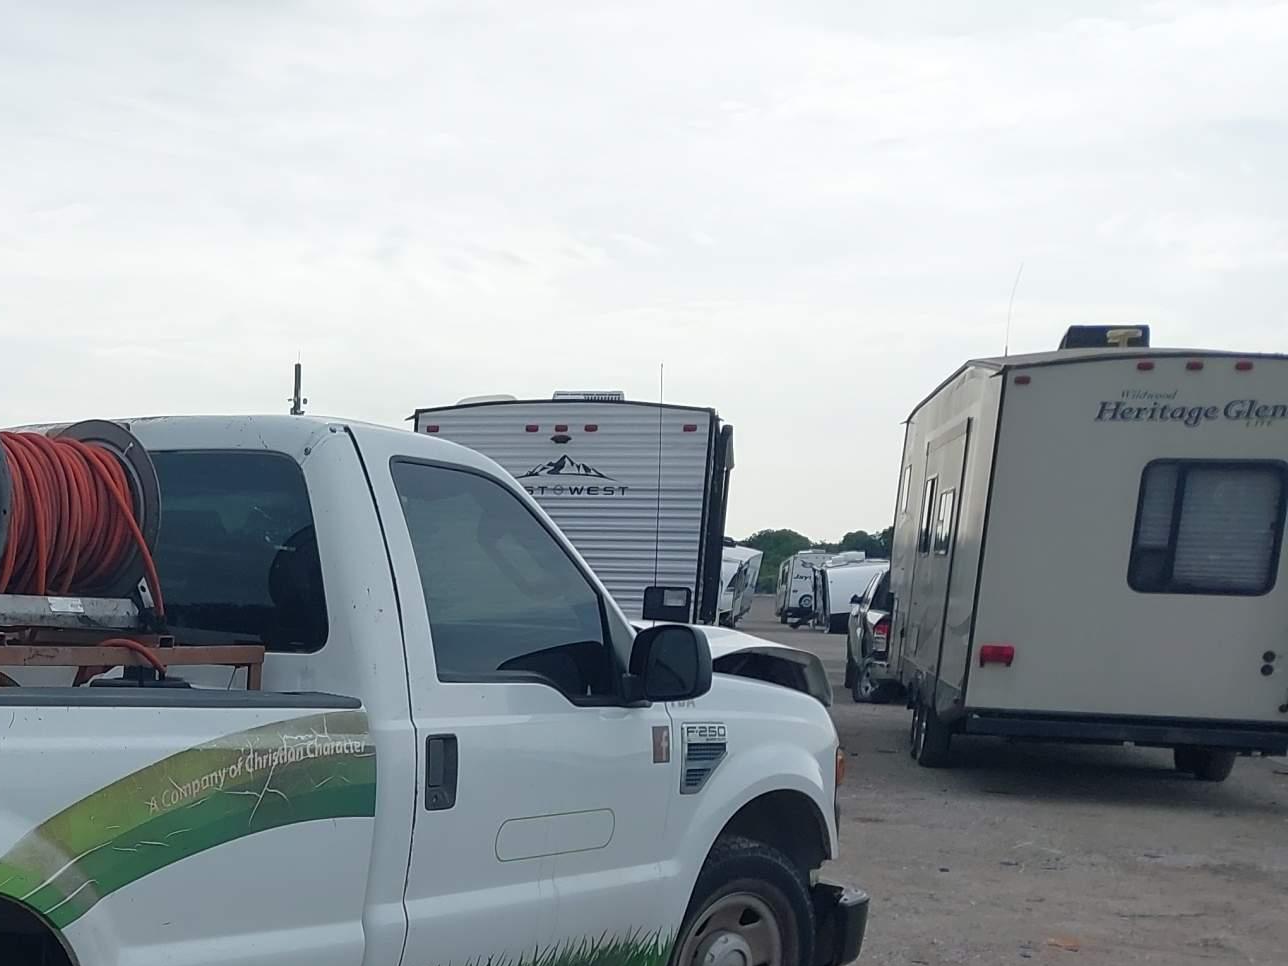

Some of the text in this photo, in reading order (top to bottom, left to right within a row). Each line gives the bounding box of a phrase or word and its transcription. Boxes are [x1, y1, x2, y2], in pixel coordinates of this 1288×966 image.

[1094, 399, 1288, 427] Heritage Glen
[148, 739, 366, 814] A Company of Christian Character
